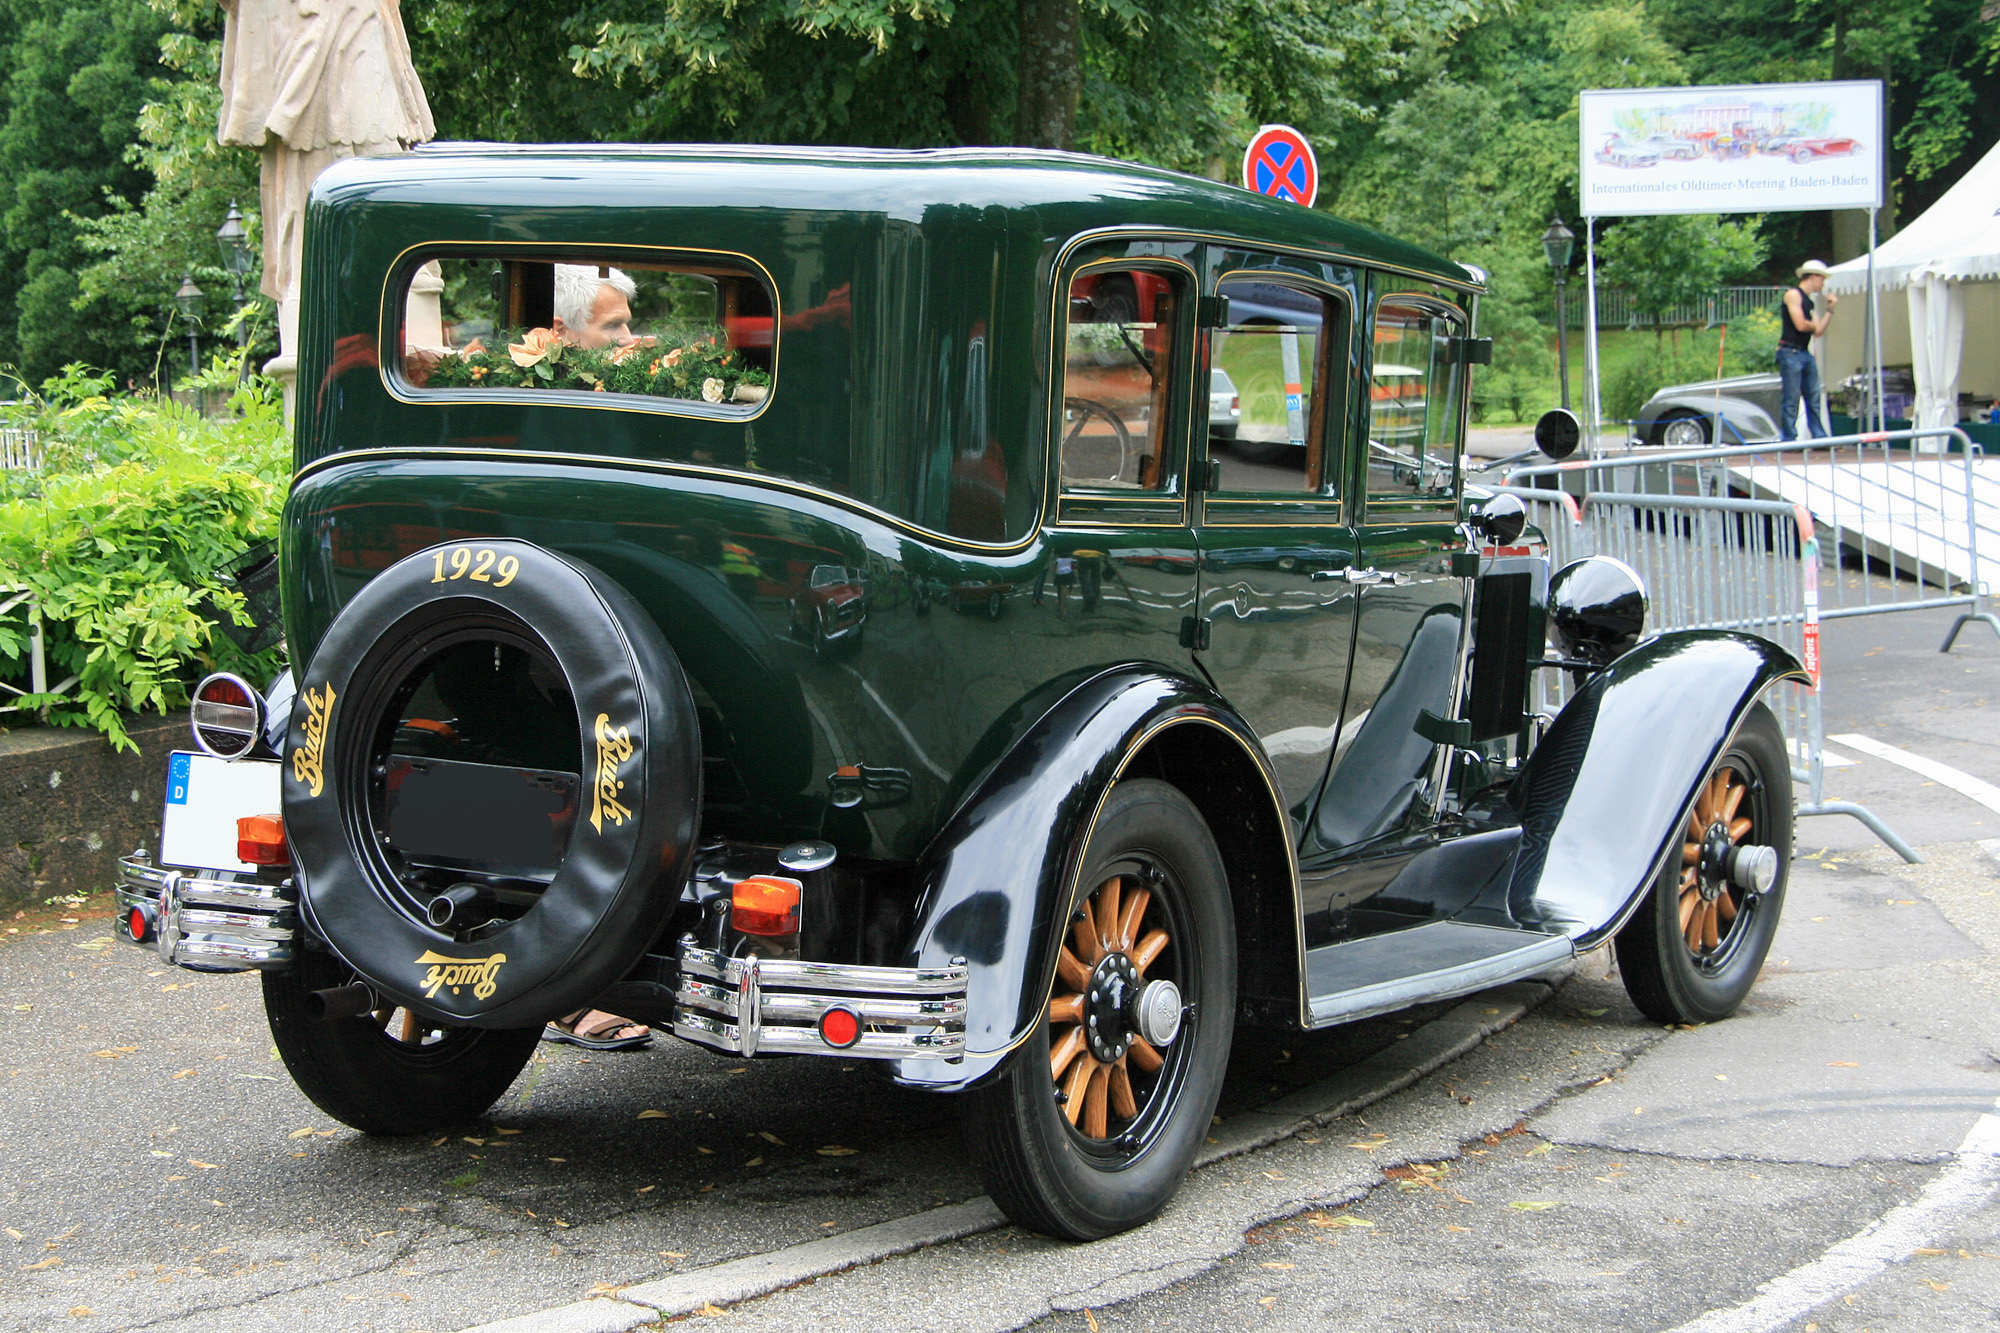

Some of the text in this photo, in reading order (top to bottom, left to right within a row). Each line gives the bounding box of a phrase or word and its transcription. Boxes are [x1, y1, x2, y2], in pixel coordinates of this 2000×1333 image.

[1591, 175, 1868, 194] Internationales Oldtimer-Meeting Baden-Baden
[431, 547, 520, 588] 1929
[293, 681, 337, 798] Buick
[174, 786, 184, 799] D
[590, 713, 634, 836] Buick
[414, 949, 507, 1000] Buick
